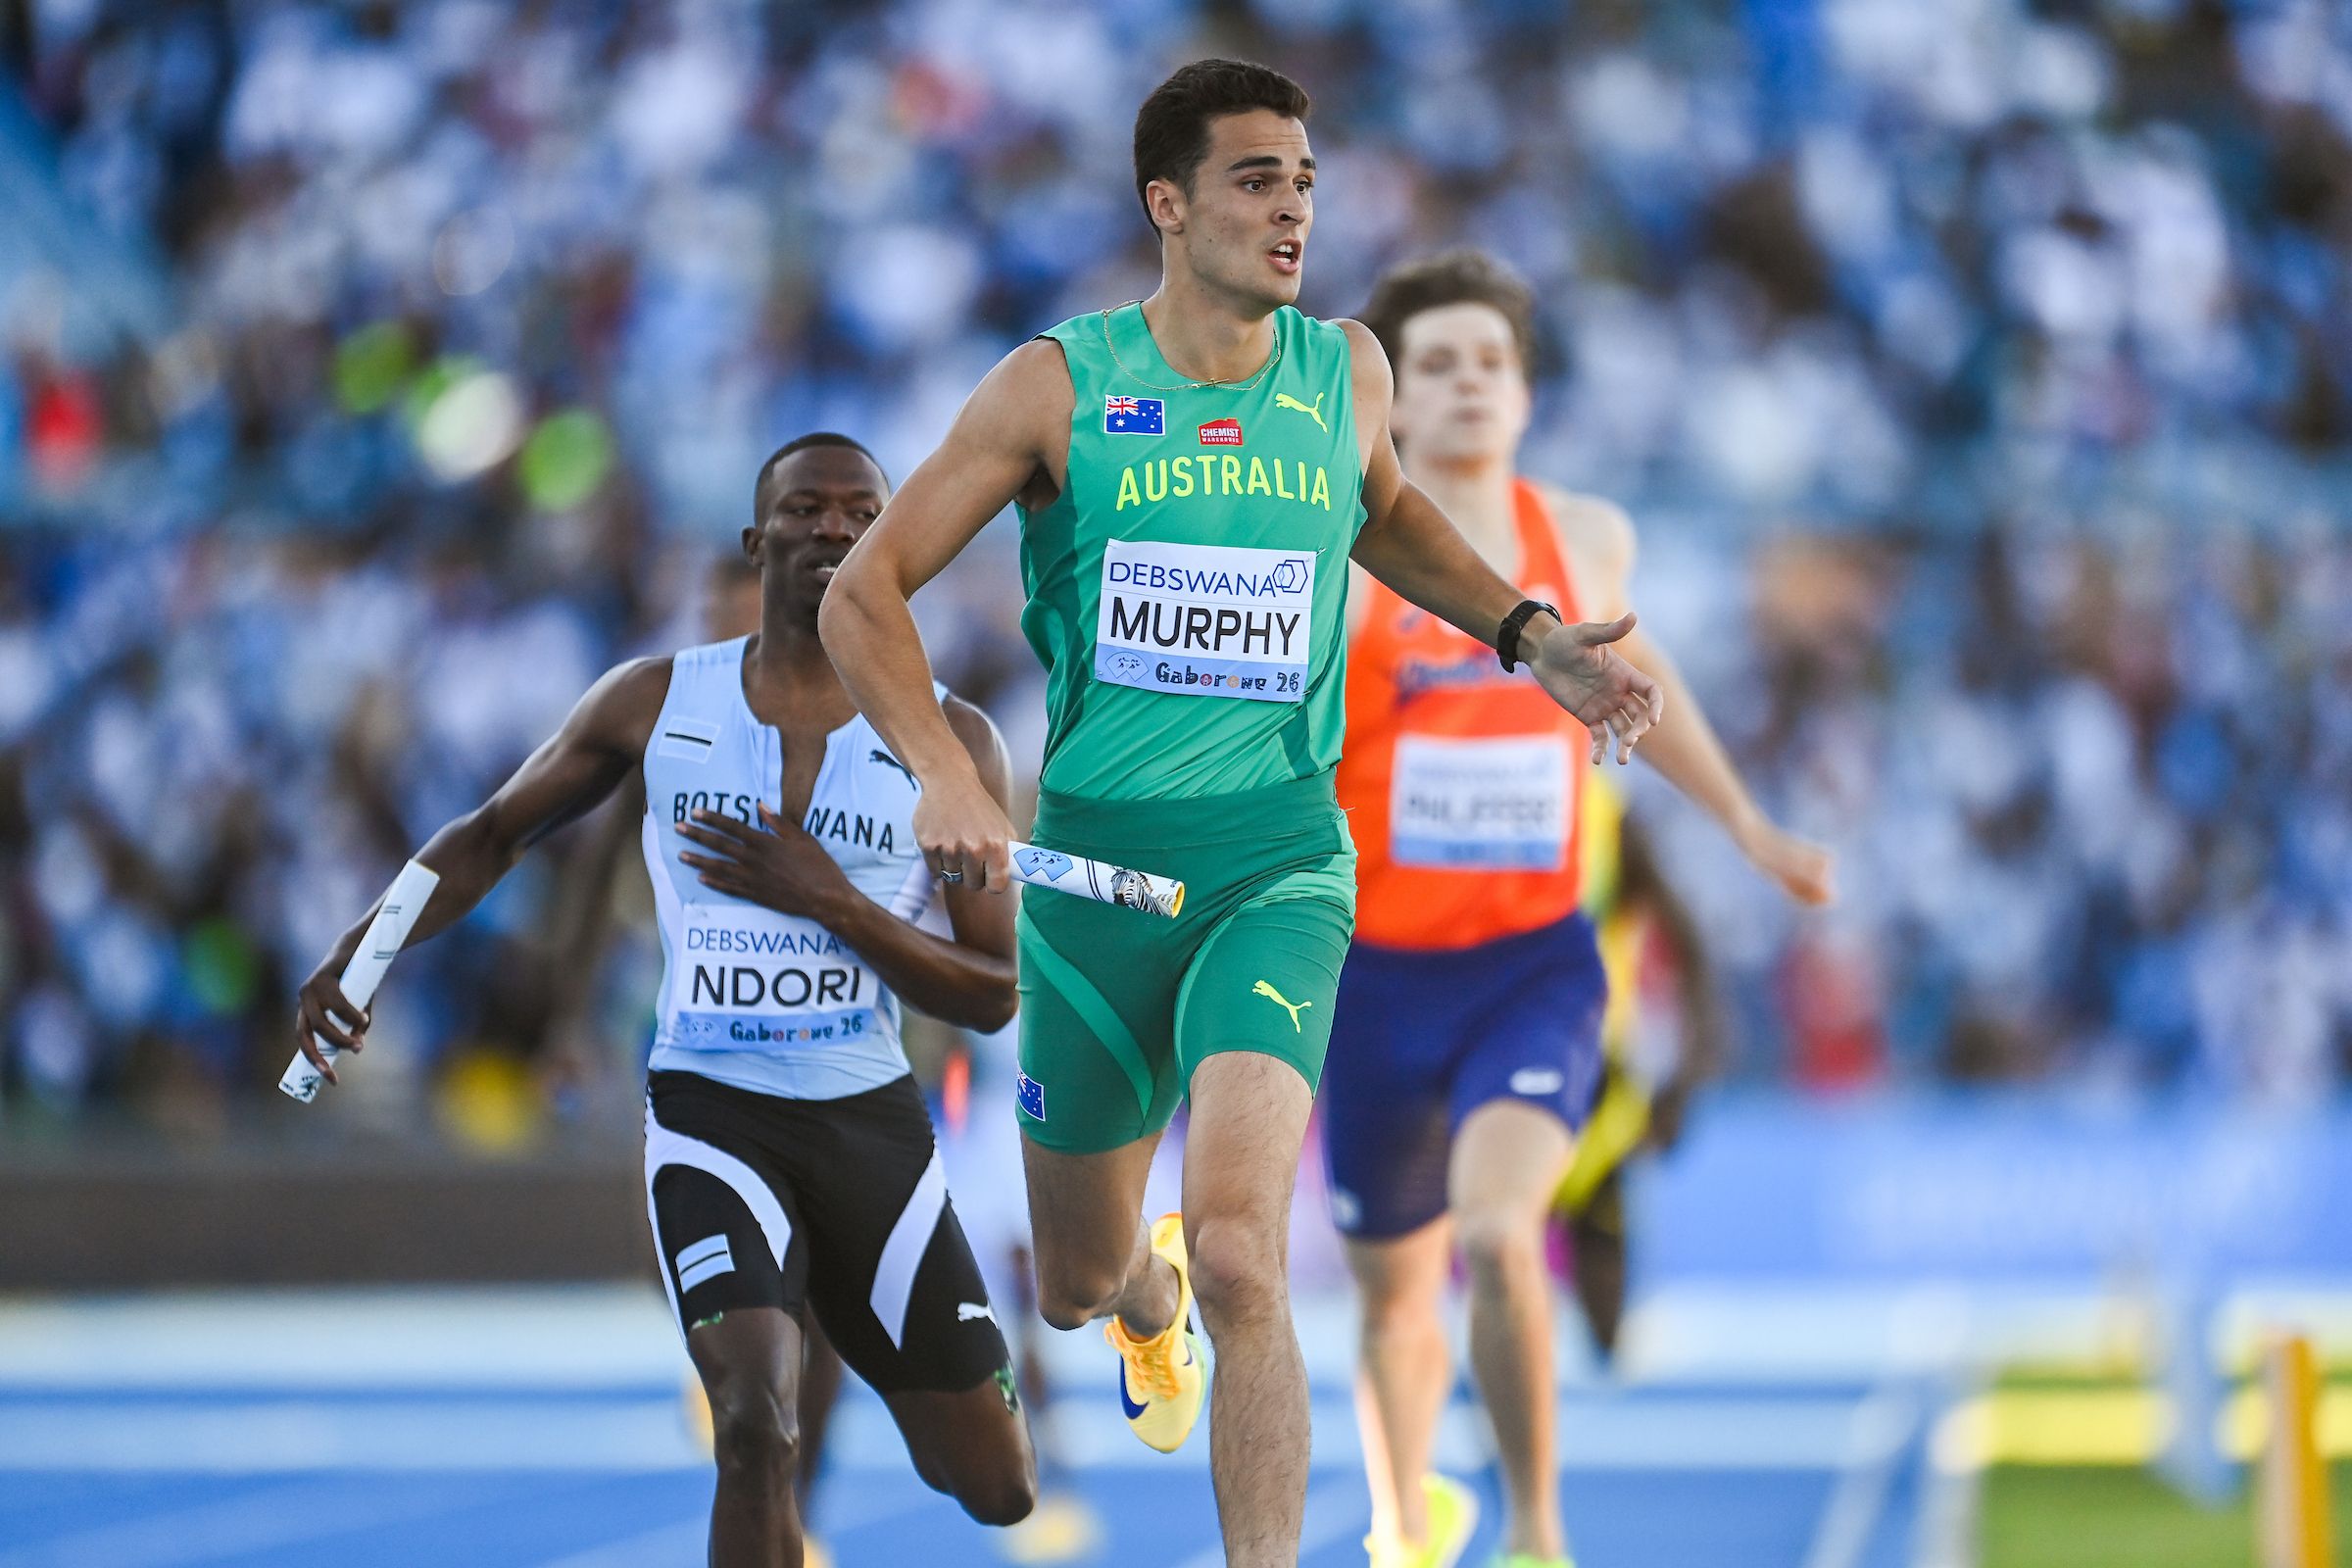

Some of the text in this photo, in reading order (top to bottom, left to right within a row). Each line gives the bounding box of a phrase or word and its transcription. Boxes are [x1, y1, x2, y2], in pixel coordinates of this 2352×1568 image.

[1200, 427, 1239, 437] CHEMIST
[1115, 454, 1331, 511] AUSTRALIA
[1109, 562, 1277, 598] DEBSWANA
[1110, 596, 1301, 656] MURPHY
[1155, 662, 1300, 693] Gaborone 26
[687, 927, 841, 956] DEBSWANA
[691, 963, 860, 1007] NDORI
[840, 1013, 863, 1036] 26
